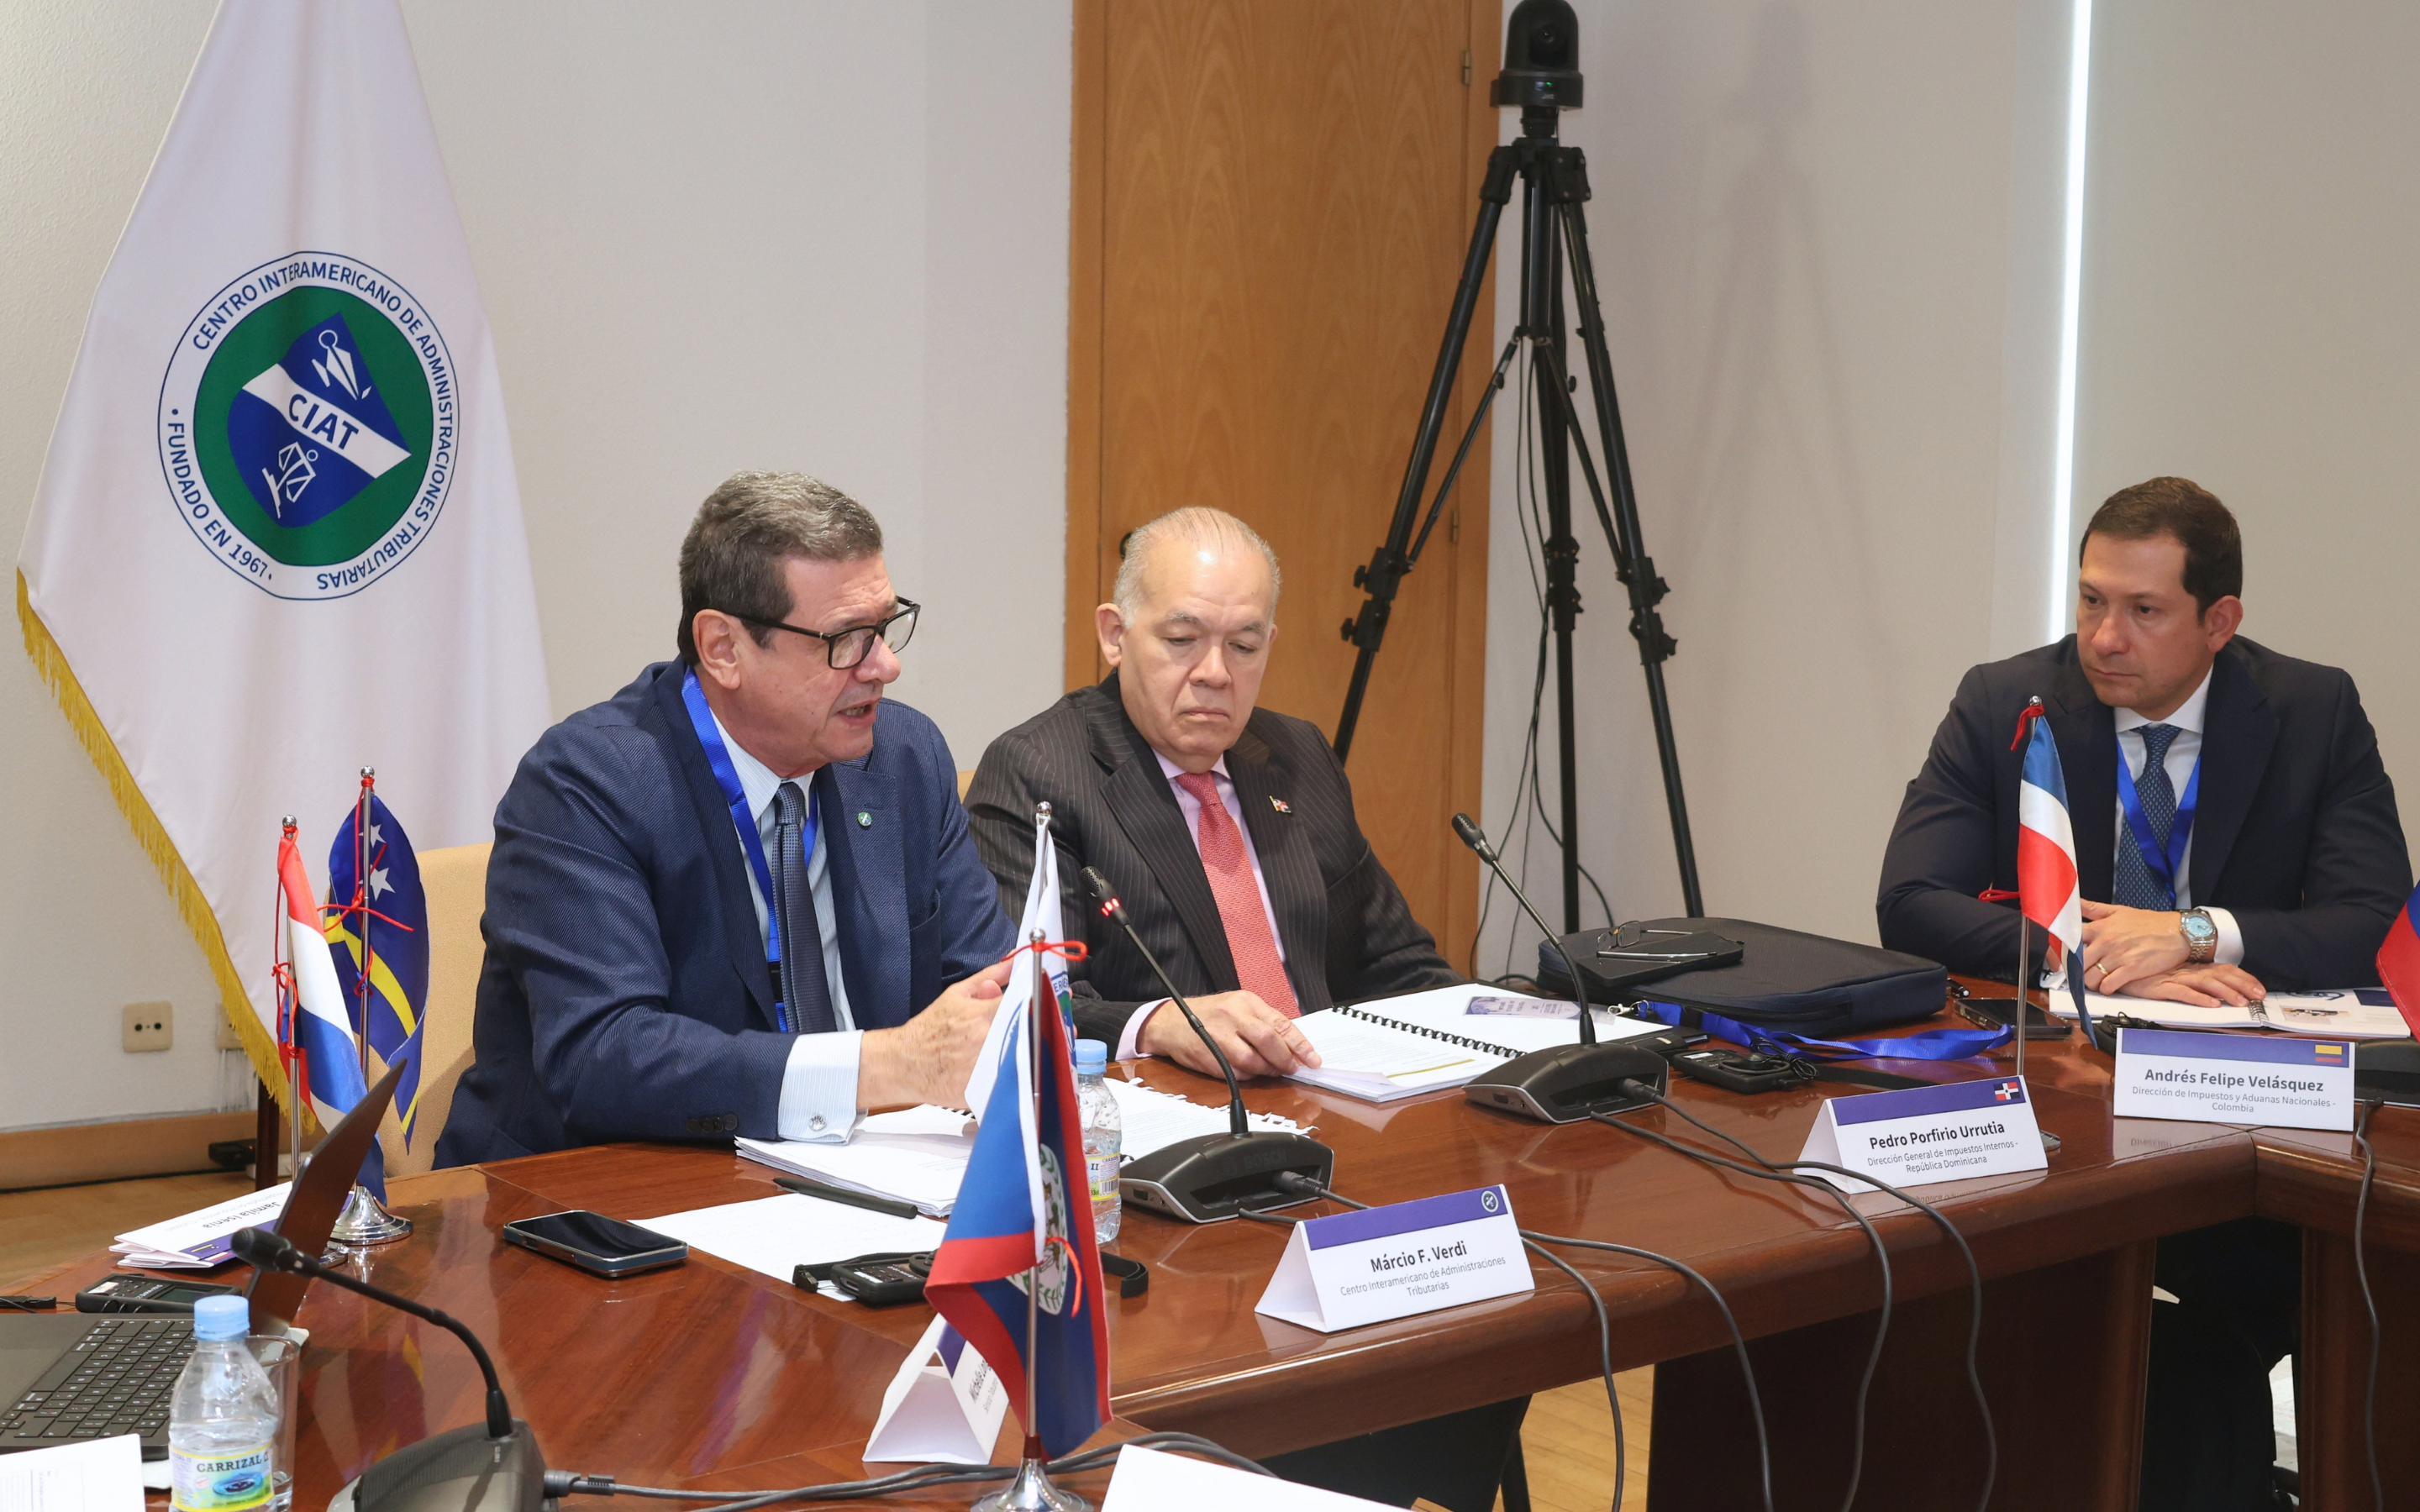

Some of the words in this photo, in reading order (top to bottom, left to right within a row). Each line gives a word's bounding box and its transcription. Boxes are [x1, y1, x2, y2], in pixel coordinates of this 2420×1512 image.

[258, 261, 401, 312] INTERAMERICANO
[192, 284, 258, 350] CENTRO
[398, 307, 424, 335] DE
[288, 393, 360, 450] CIAT
[415, 333, 453, 521] ADMINISTRACIONES
[167, 423, 210, 521] FUNDADO
[203, 519, 233, 548] EN
[228, 543, 269, 580] 1967
[317, 525, 422, 591] TRIBUTARIAS
[2144, 1068, 2196, 1084] Andrés
[2200, 1072, 2244, 1089] Felipe
[2248, 1075, 2324, 1093] Velásquez
[2132, 1086, 2173, 1097] Dirección
[2175, 1089, 2186, 1098] de
[2187, 1090, 2233, 1101] Impuestos
[2235, 1094, 2241, 1103] y
[2242, 1093, 2281, 1104] Aduanas
[2282, 1096, 2331, 1107] Nacionales
[2212, 1102, 2254, 1113] Colombia
[1869, 1134, 1908, 1150] Pedro
[1909, 1126, 1958, 1145] Porfirio
[1960, 1121, 2005, 1138] Urrutia
[1867, 1153, 1903, 1167] Dirección
[1904, 1150, 1933, 1162] General
[1933, 1147, 1944, 1158] de
[1944, 1143, 1983, 1158] Impuestos
[1984, 1140, 2014, 1151] Internos
[1906, 1158, 1943, 1173] República
[1944, 1156, 1987, 1168] Dominicana
[202, 1215, 240, 1229] Isenia
[239, 1201, 281, 1216] Jamila
[1370, 1251, 1416, 1273] Márcio
[1418, 1249, 1431, 1263] F.
[1432, 1240, 1467, 1260] Verdi
[1340, 1281, 1368, 1296] Centro
[1369, 1272, 1428, 1291] Interamericano
[1430, 1267, 1440, 1278] de
[1440, 1256, 1507, 1277] Administraciones
[1407, 1280, 1449, 1296] Tributarias
[197, 1455, 262, 1473] CARRIZAL
